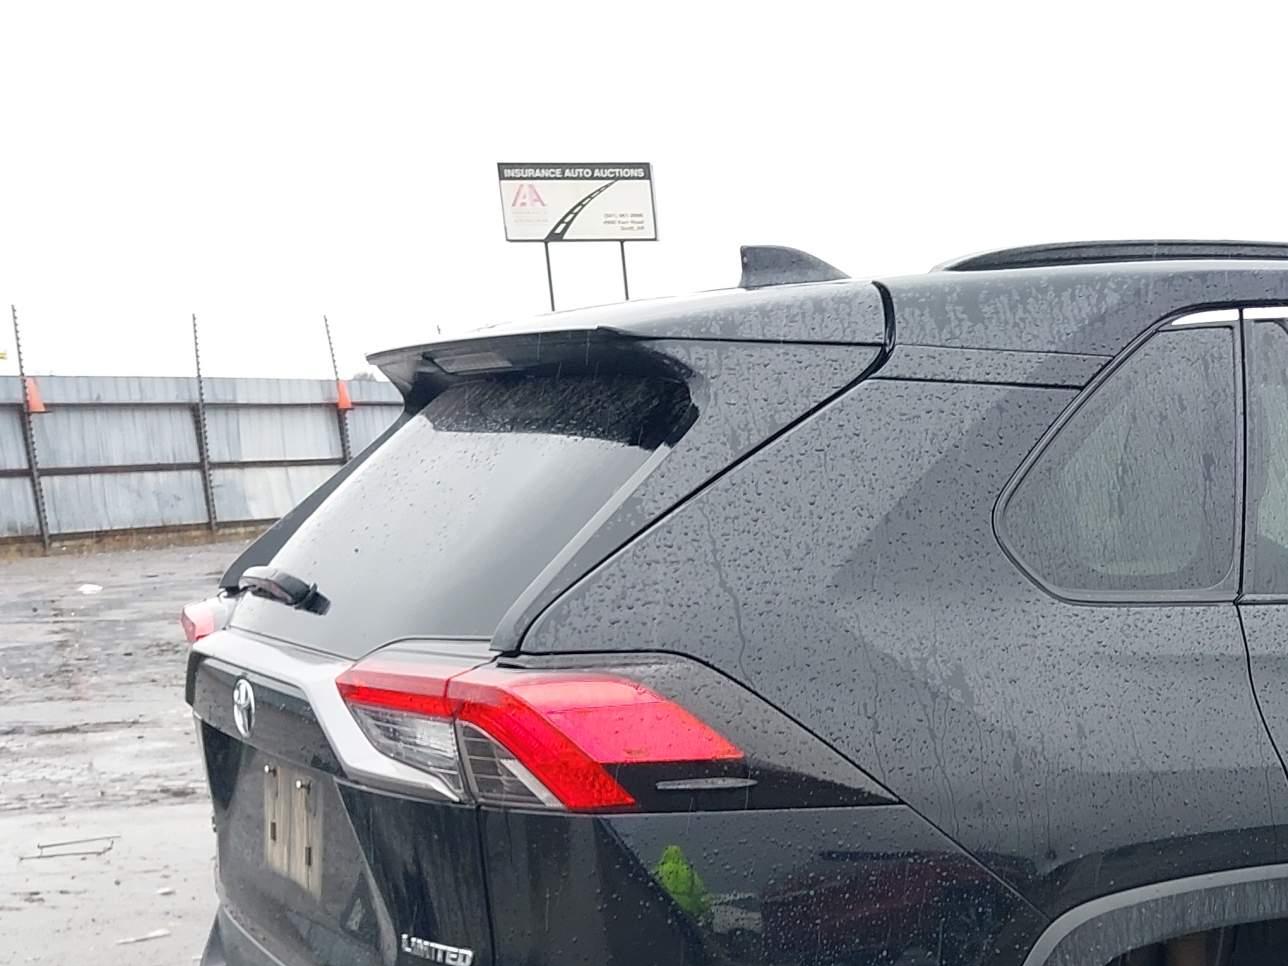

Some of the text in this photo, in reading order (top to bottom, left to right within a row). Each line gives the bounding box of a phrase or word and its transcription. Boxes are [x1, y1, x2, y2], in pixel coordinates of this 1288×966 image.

[504, 168, 645, 178] INSURANCE AUTO AUCTIONS
